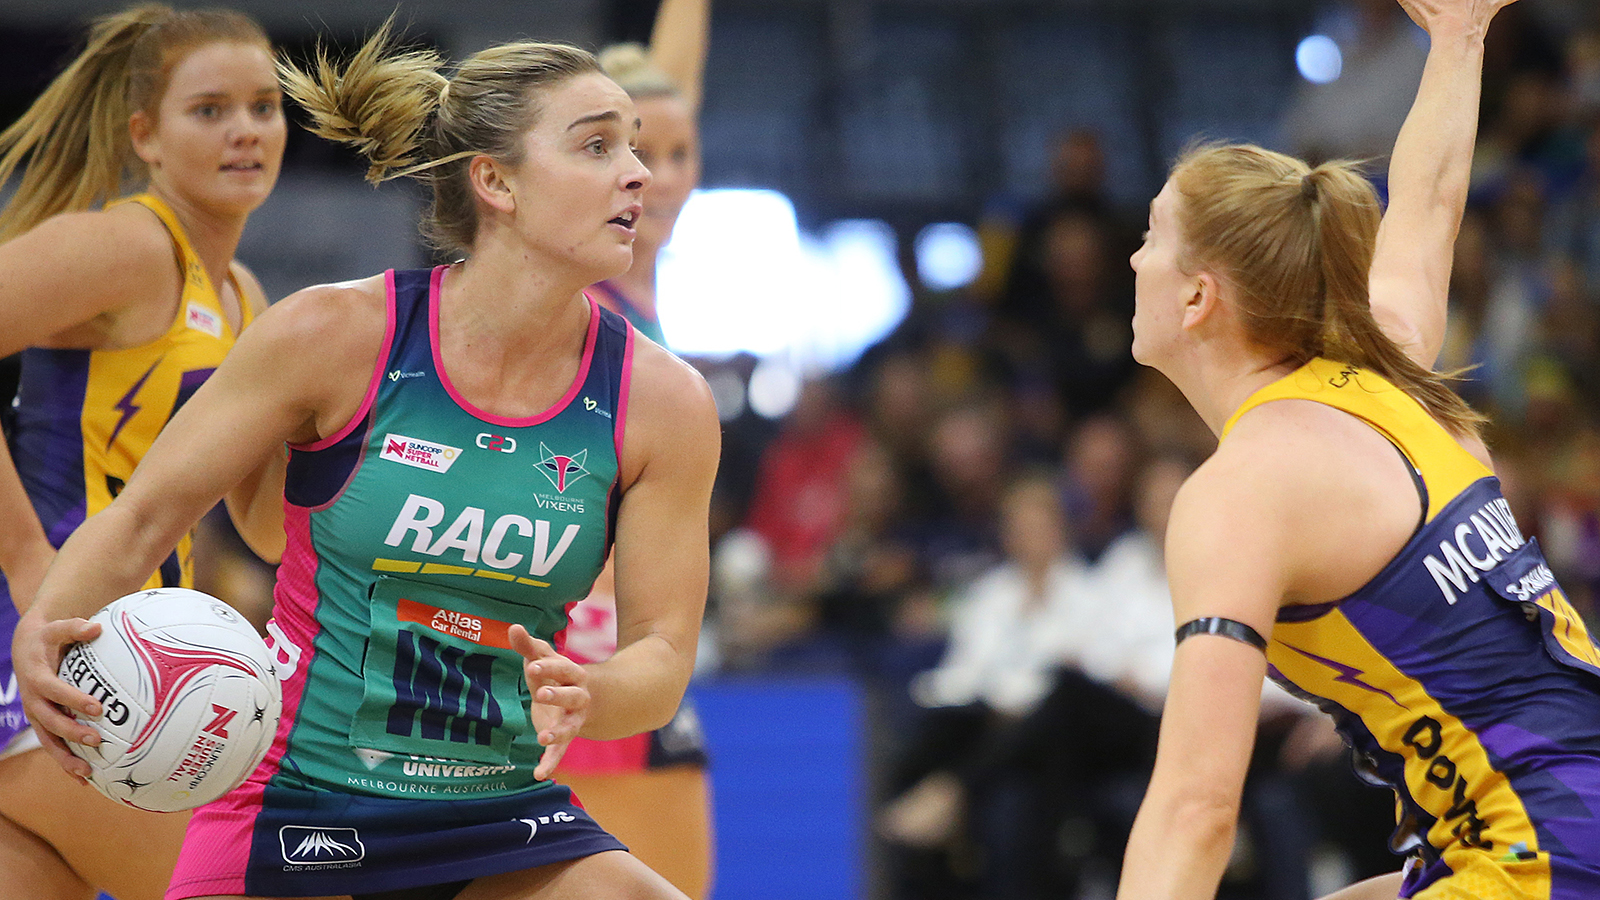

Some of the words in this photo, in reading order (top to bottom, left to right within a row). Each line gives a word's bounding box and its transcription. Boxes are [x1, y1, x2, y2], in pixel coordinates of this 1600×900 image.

[406, 448, 432, 459] SUPER
[408, 442, 442, 454] SUNCORP
[404, 454, 439, 467] NETBALL
[533, 492, 585, 513] VIXENS
[538, 493, 585, 503] MELBOURNE
[384, 494, 581, 577] RACV
[433, 609, 482, 631] Atlas
[431, 620, 449, 633] Car
[450, 624, 482, 642] Rental
[386, 629, 503, 746] WA
[167, 735, 207, 782] NETBALL
[187, 739, 216, 776] SUPER
[189, 742, 226, 790] SUNCORP
[403, 761, 516, 777] UNIVERSITY
[347, 776, 437, 794] MELBOURNE
[443, 781, 508, 794] AUSTRALIA
[283, 864, 303, 872] CMS
[304, 861, 362, 871] AUSTRALASIA
